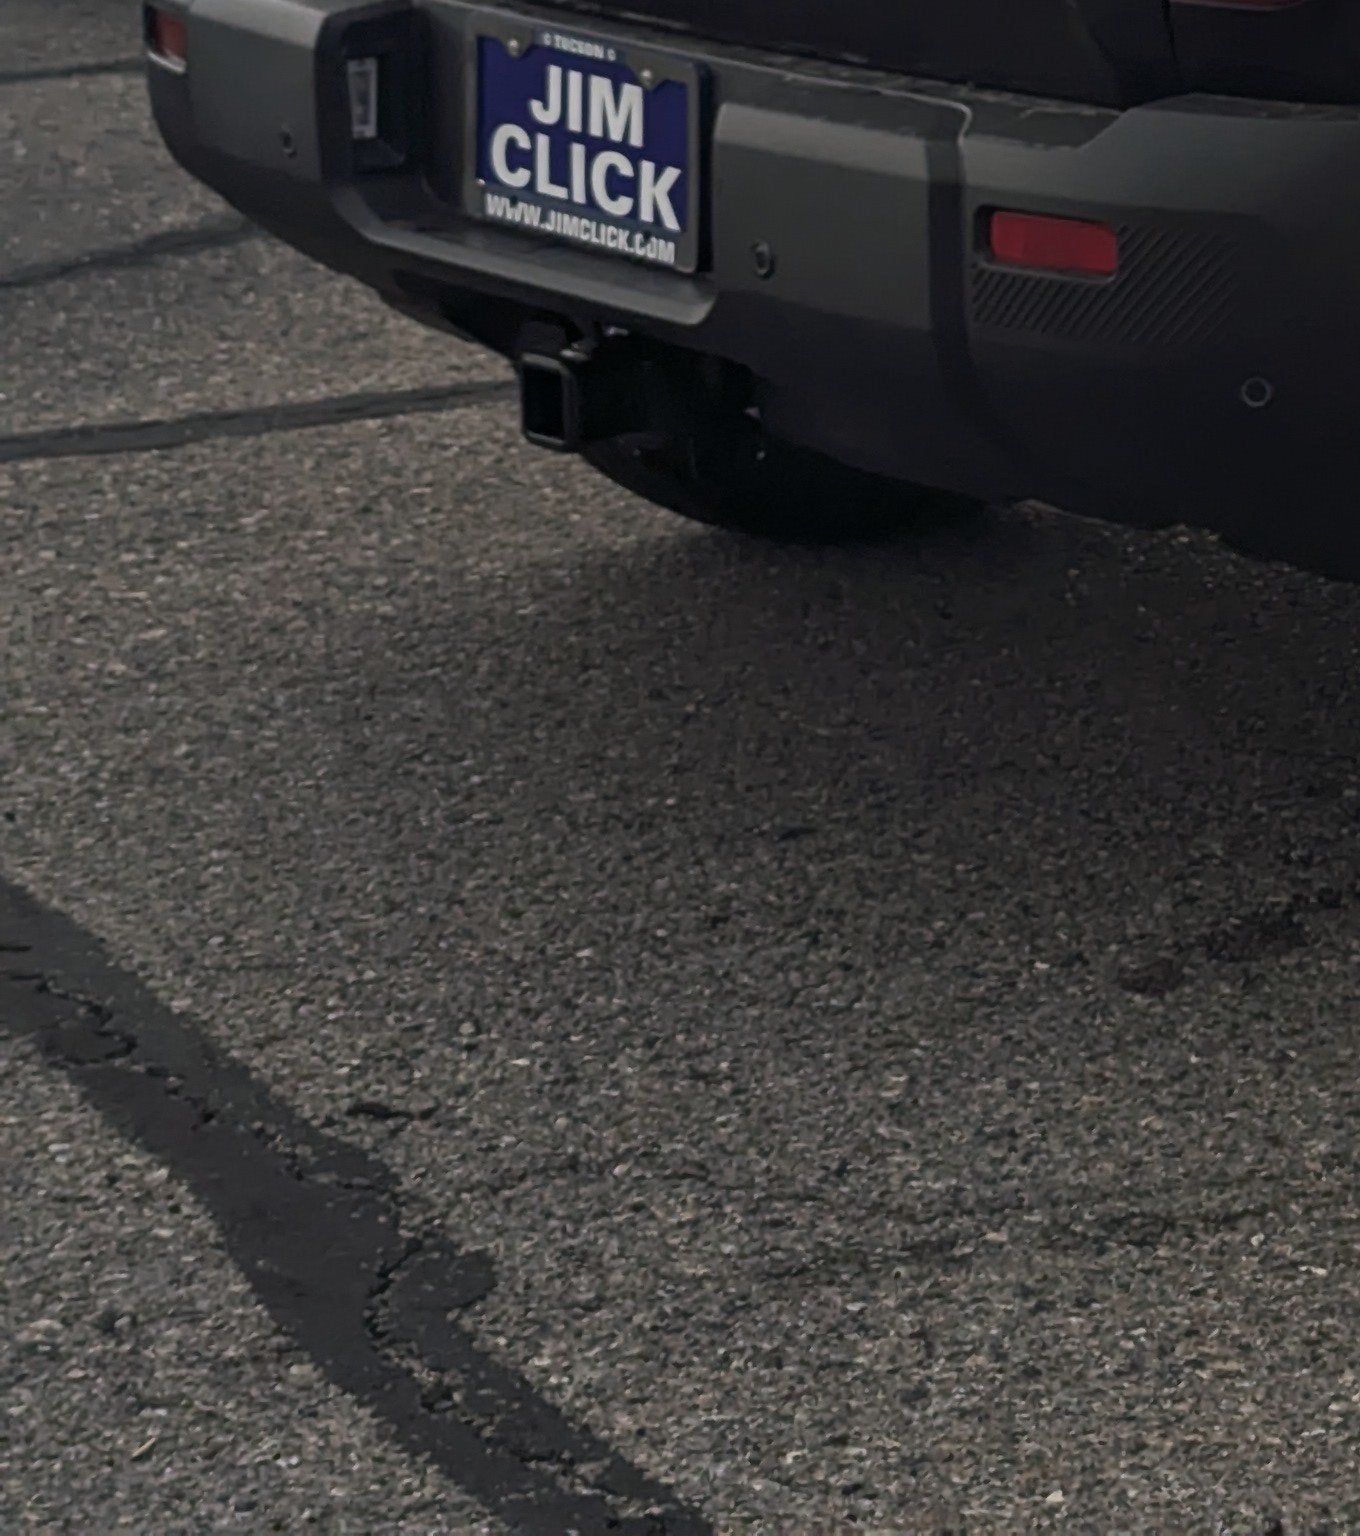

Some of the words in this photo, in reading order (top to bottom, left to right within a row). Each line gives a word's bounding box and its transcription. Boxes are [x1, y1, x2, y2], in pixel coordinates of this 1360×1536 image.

[529, 64, 643, 147] JIM
[490, 123, 681, 232] CLICK
[485, 192, 676, 265] WWW.JIMCLICK.COM
